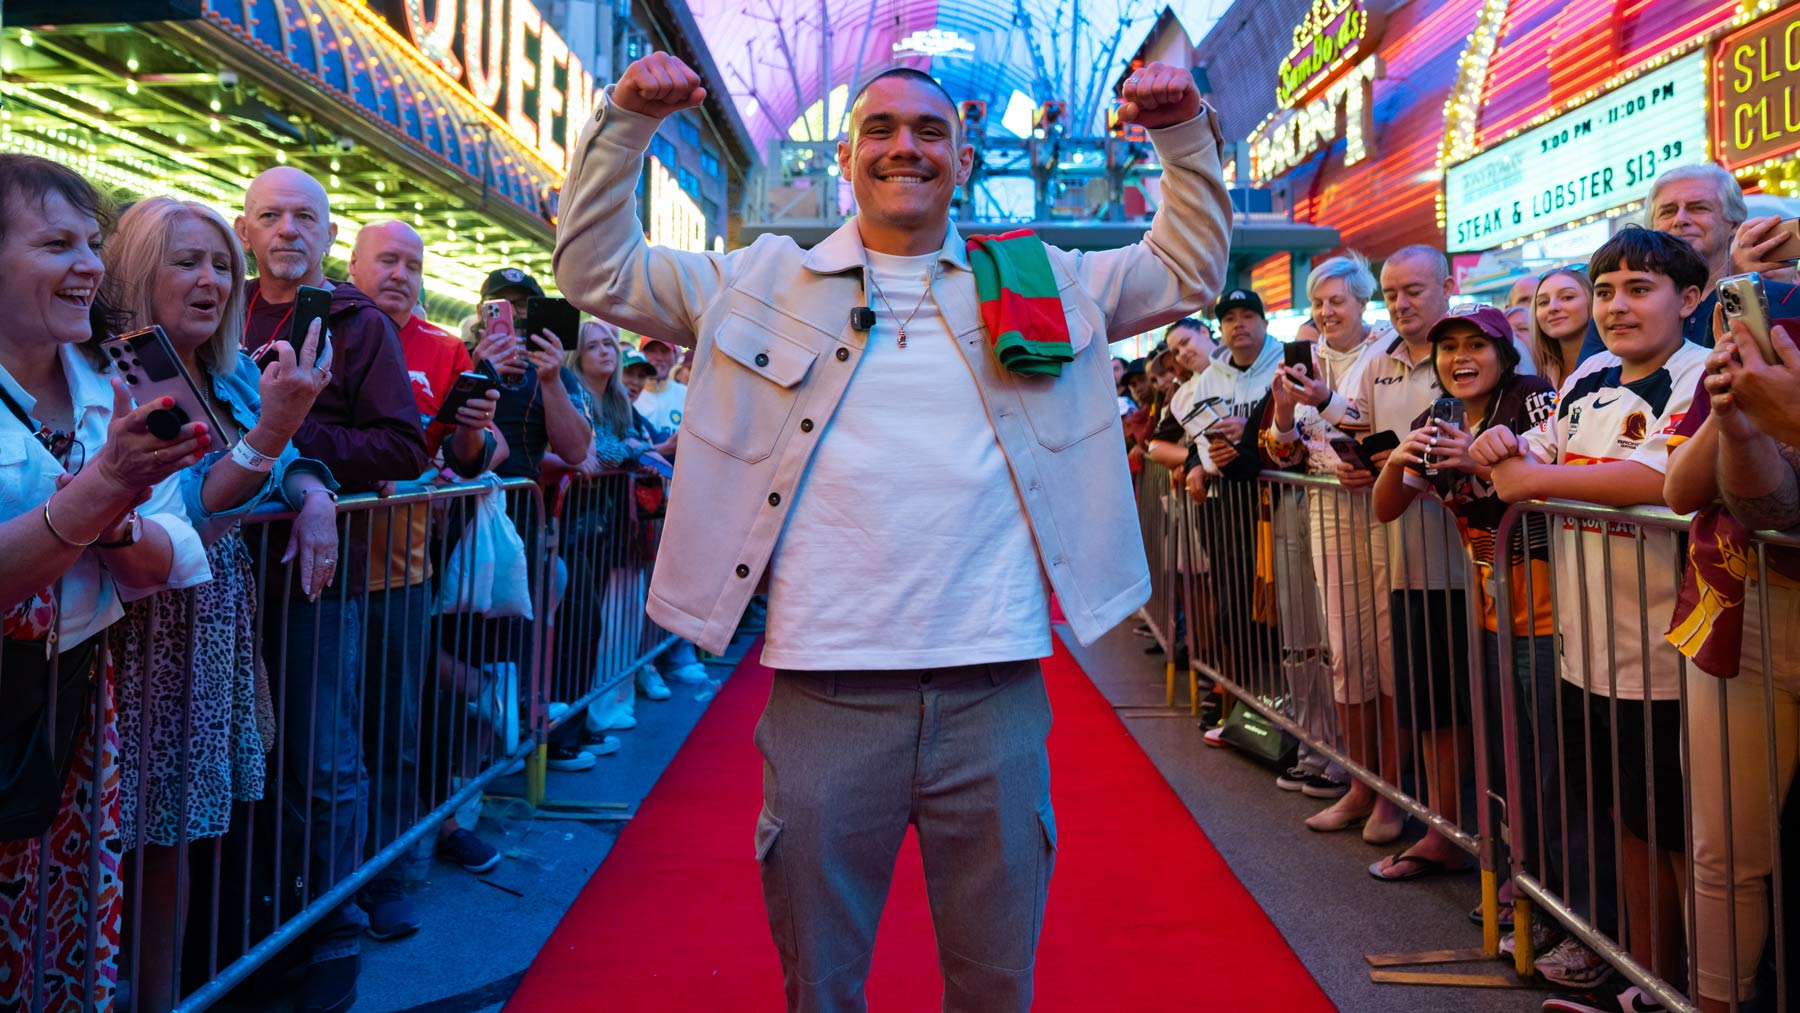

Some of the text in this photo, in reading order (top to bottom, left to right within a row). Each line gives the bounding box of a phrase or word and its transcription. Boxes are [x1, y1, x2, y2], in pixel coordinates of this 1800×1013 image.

[1281, 55, 1312, 100] Sam
[1574, 119, 1591, 138] PM
[1608, 96, 1645, 124] 11:00
[1652, 81, 1674, 104] PM
[1457, 207, 1502, 244] STEAK
[1512, 201, 1521, 224] &
[1533, 167, 1613, 218] LOBSTER
